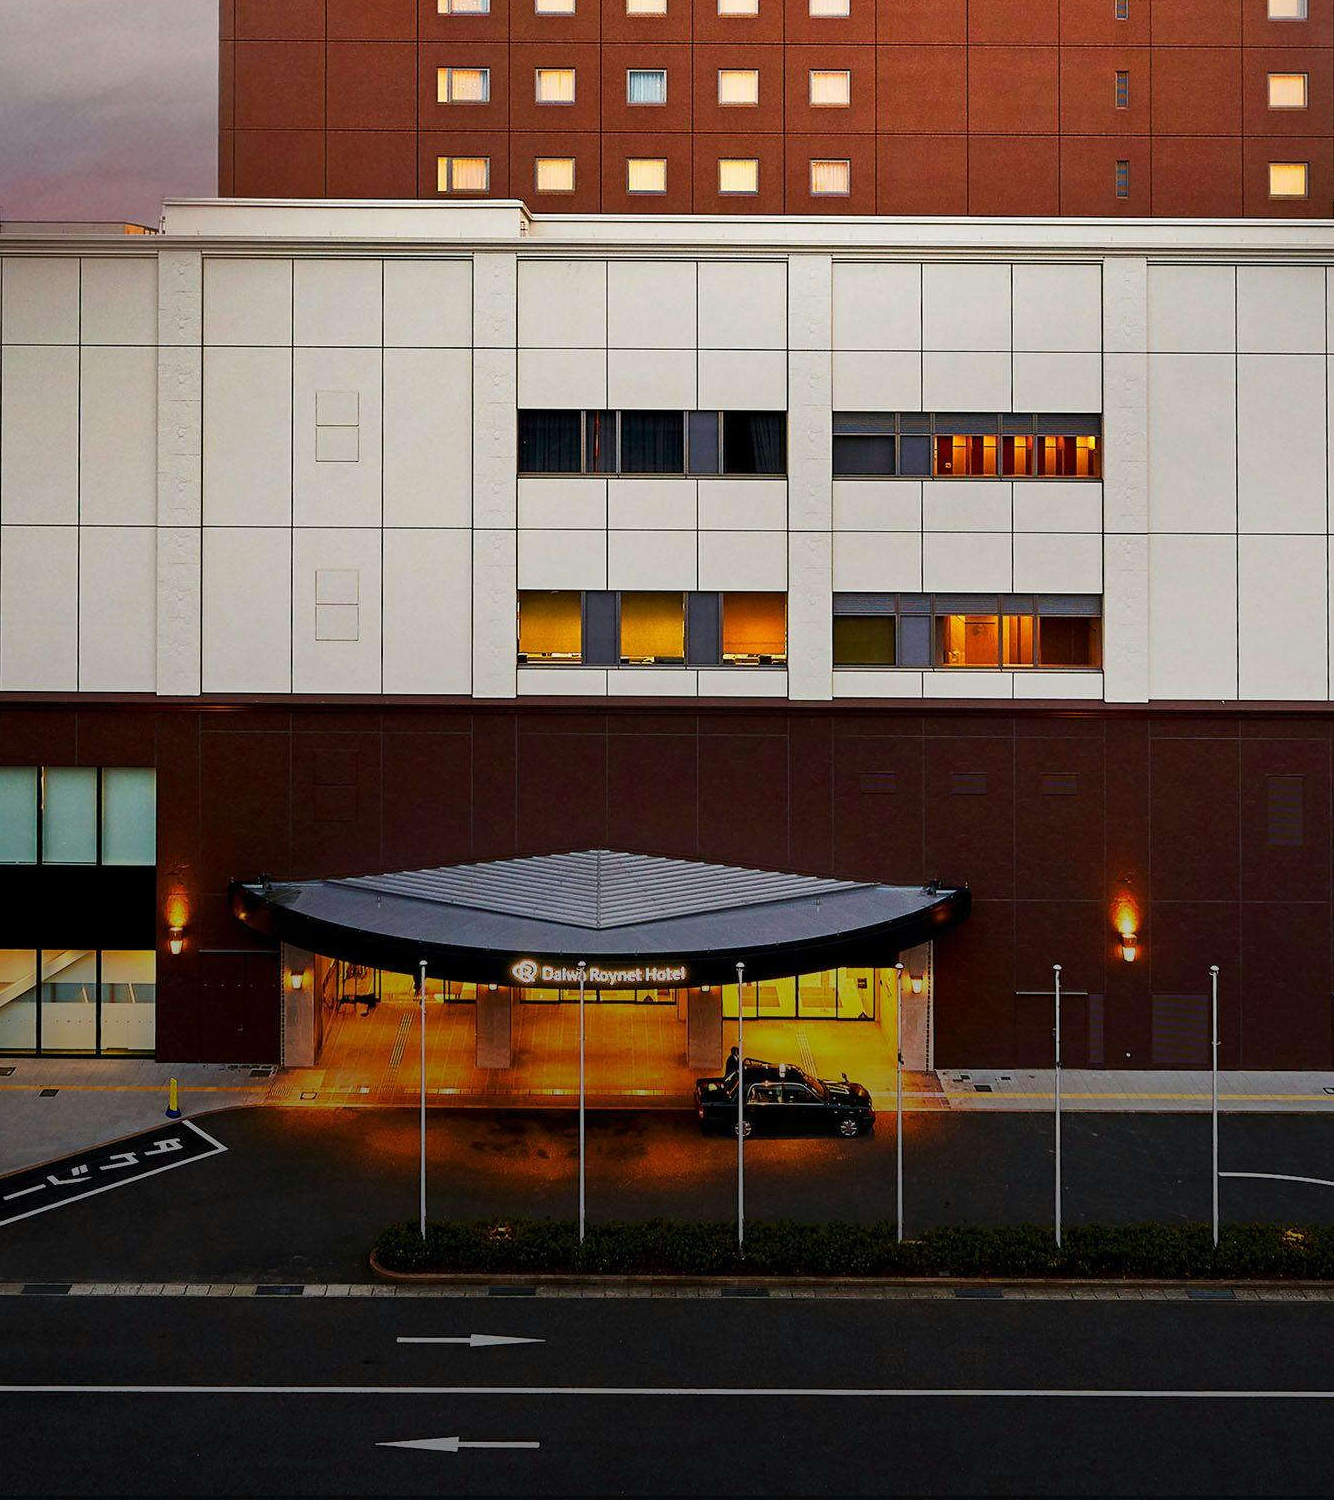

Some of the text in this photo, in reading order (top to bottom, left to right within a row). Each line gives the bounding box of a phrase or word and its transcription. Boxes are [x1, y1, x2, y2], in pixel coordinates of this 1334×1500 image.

[589, 967, 643, 986] Roynet
[645, 966, 686, 982] Hotel
[3, 1138, 184, 1201] タクシー
